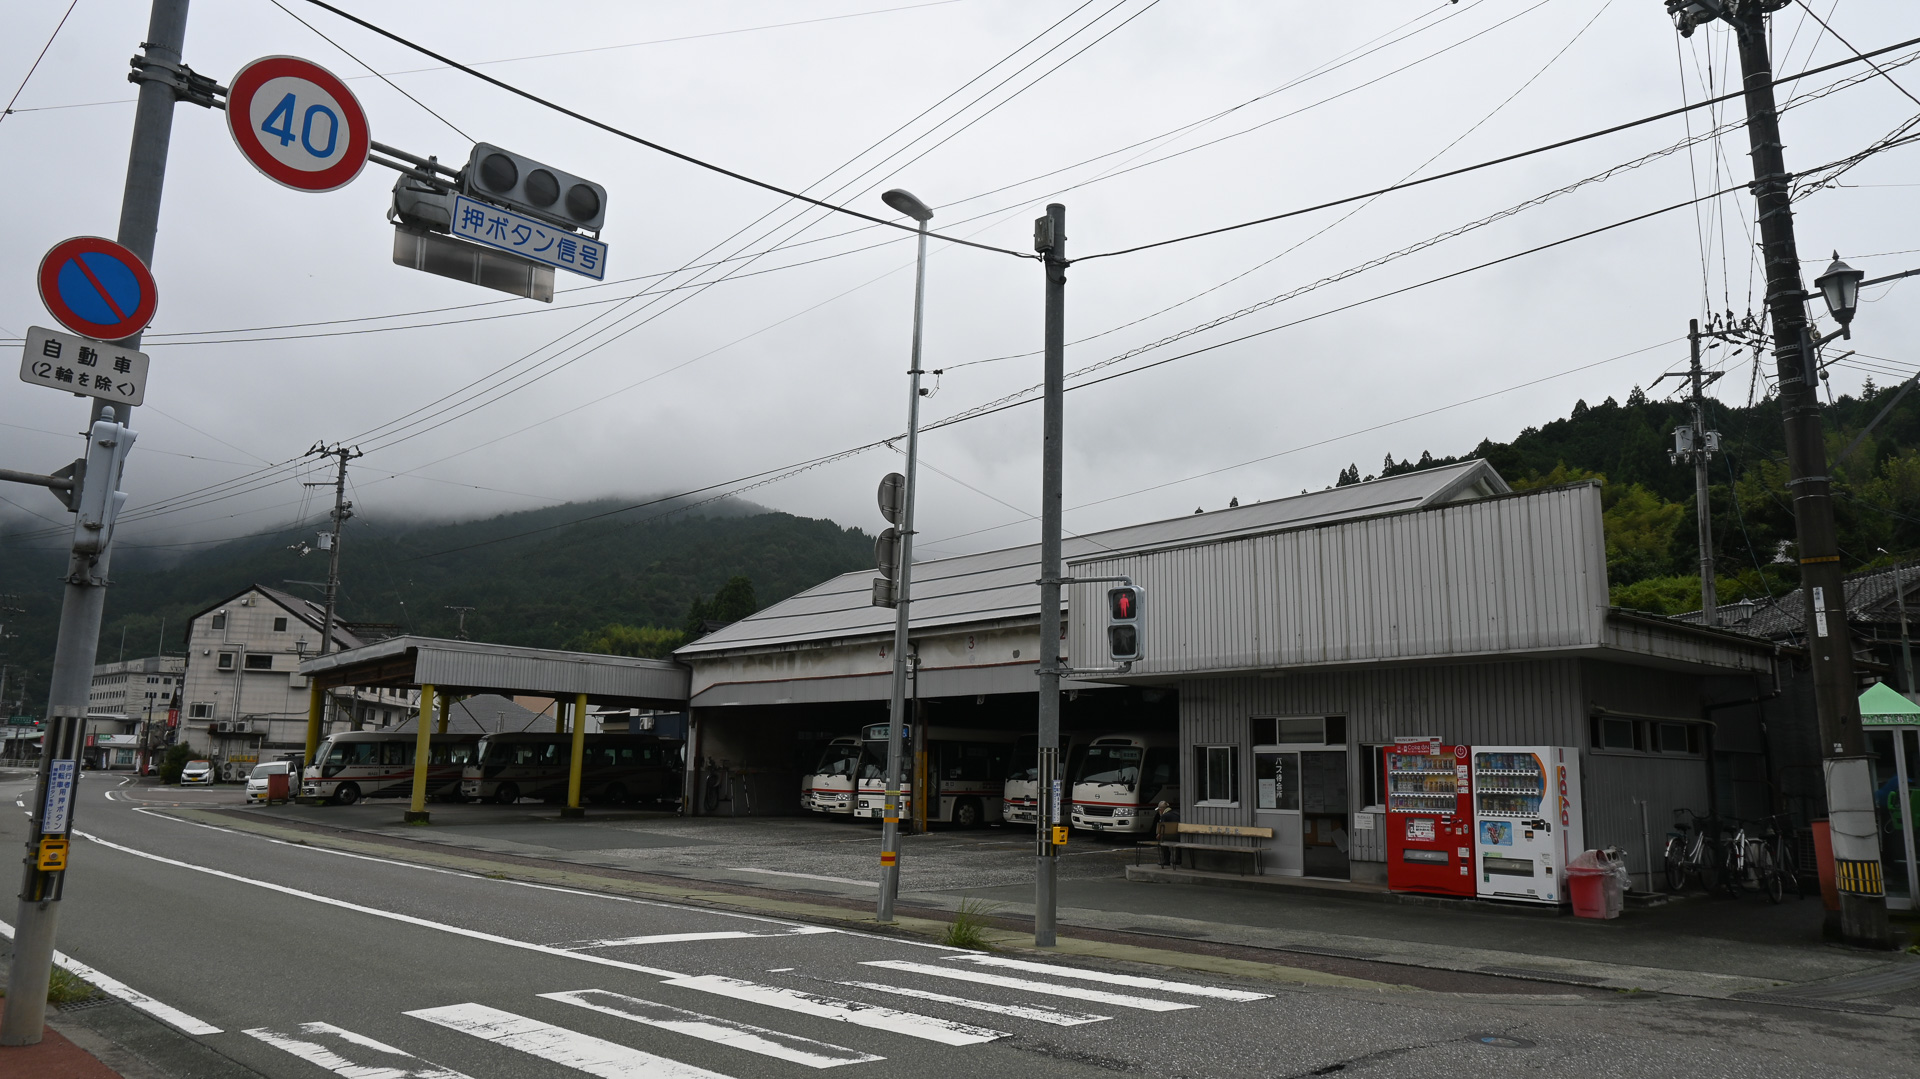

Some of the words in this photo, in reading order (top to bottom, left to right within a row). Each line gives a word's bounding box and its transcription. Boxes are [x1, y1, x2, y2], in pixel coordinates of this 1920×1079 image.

[261, 93, 339, 159] 40
[462, 205, 599, 270] 押ボタン信号
[43, 338, 132, 374] 自動車
[32, 361, 136, 396] (2輪を除く)
[968, 636, 975, 649] 3
[1060, 627, 1066, 640] 2
[879, 646, 886, 658] 4
[1275, 757, 1283, 799] バス待合所
